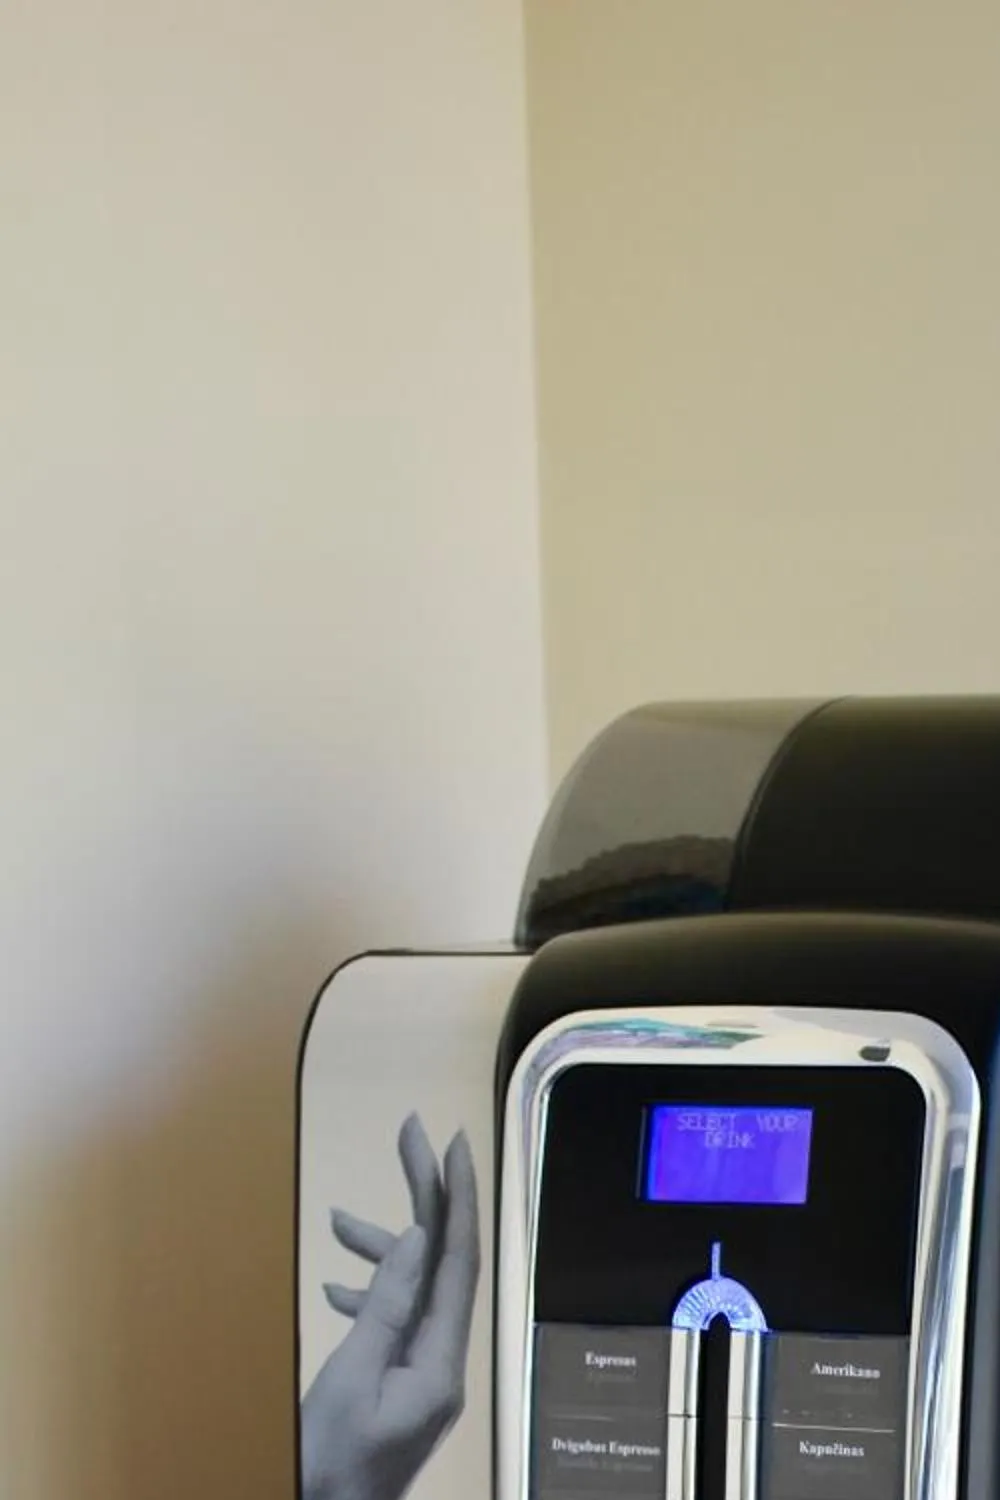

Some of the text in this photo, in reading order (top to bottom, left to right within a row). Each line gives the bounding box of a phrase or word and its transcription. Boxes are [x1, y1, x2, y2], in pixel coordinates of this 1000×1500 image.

[676, 1112, 799, 1132] SELECT YOUR
[704, 1131, 756, 1149] DRINK
[799, 1440, 865, 1458] Kapučinas
